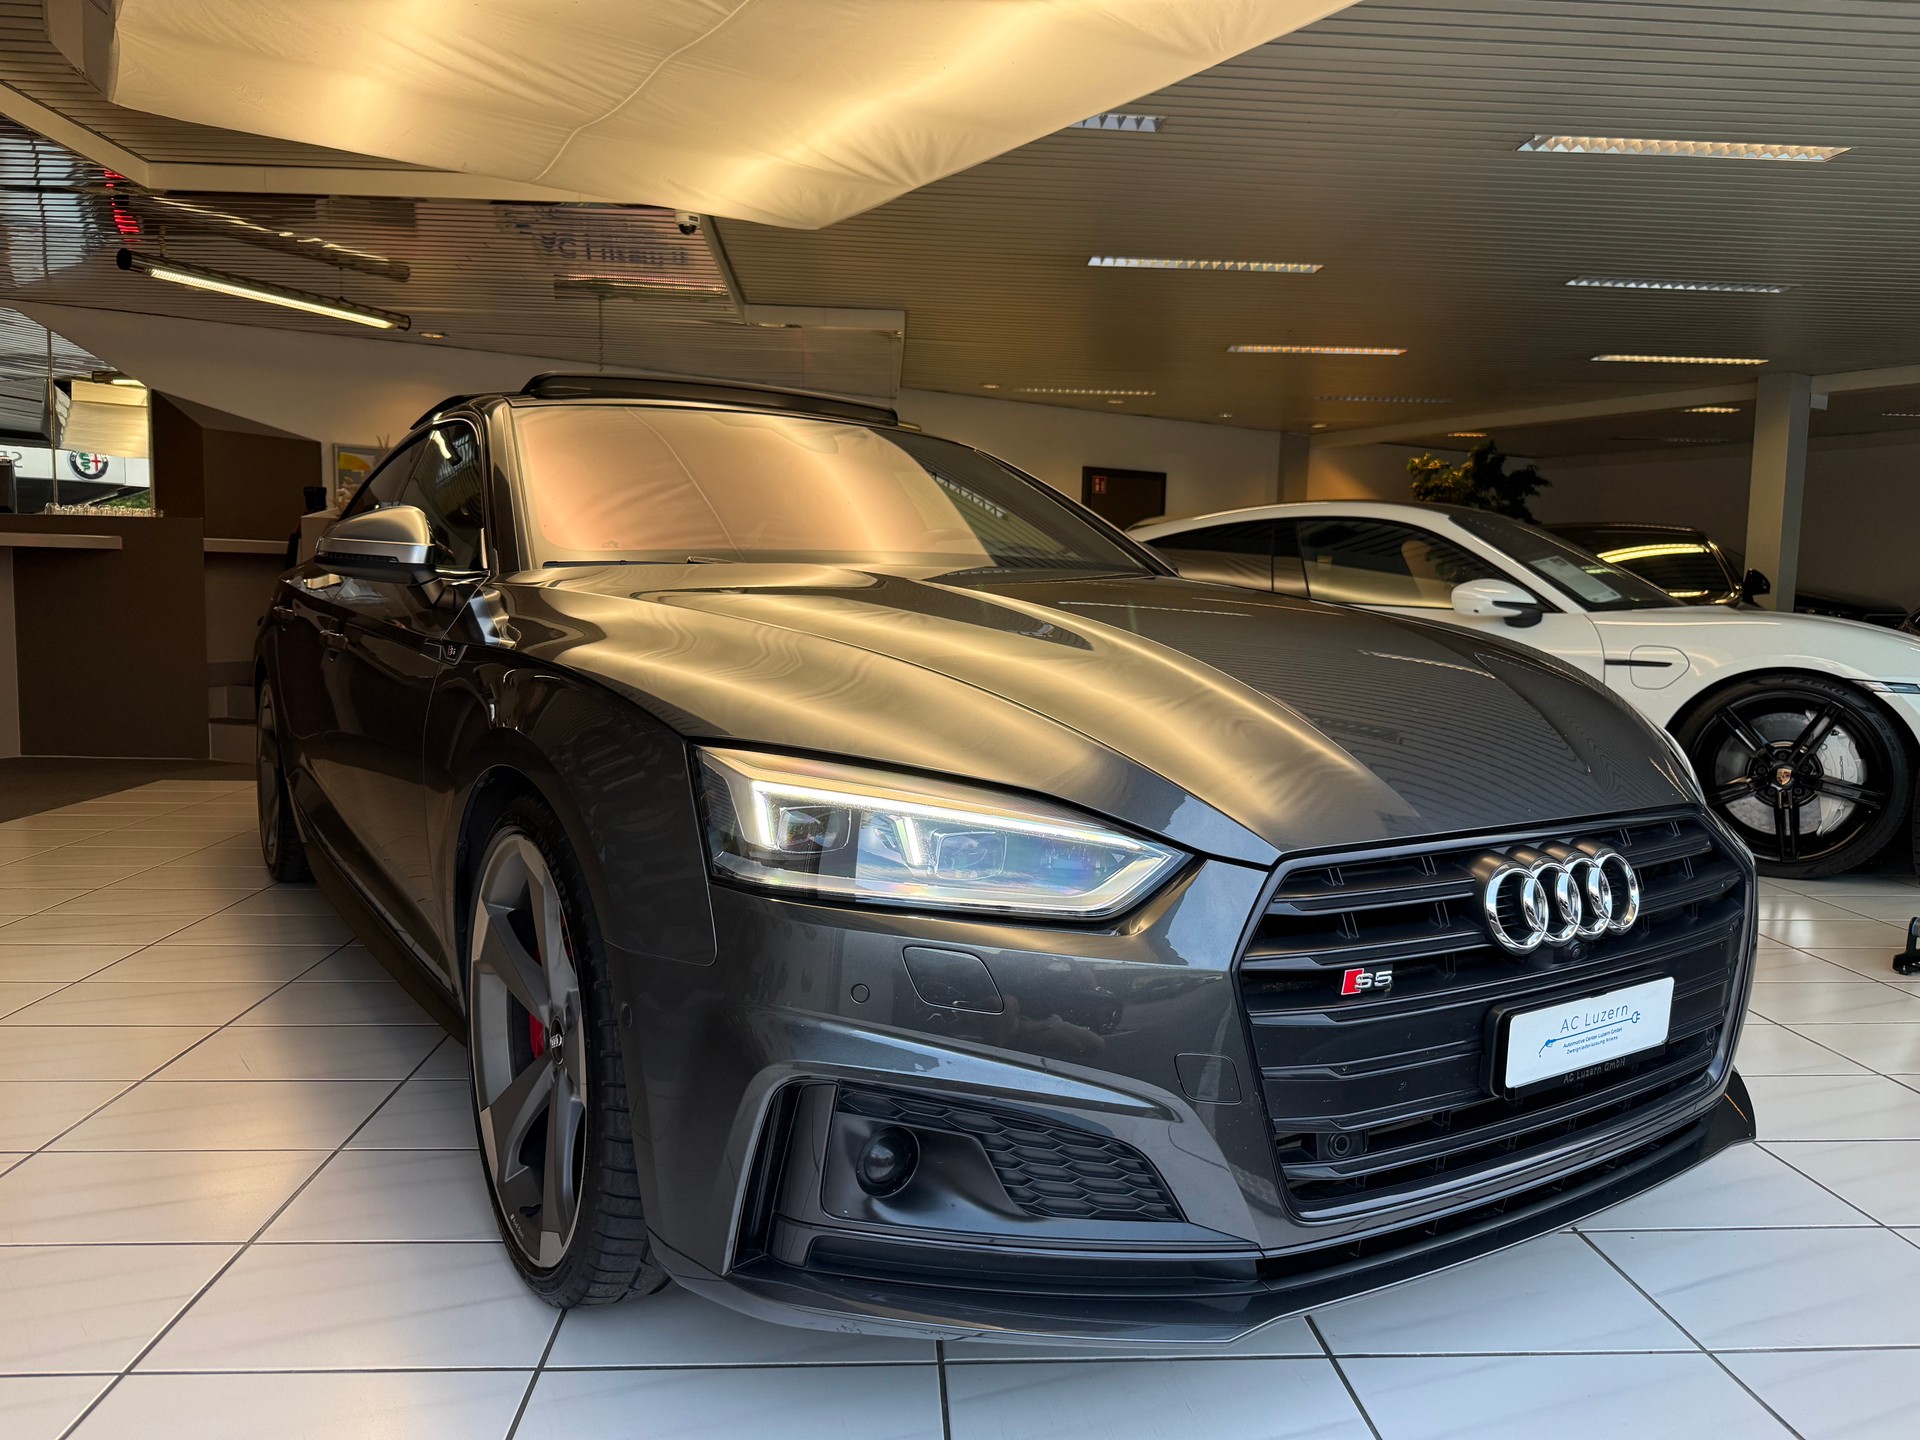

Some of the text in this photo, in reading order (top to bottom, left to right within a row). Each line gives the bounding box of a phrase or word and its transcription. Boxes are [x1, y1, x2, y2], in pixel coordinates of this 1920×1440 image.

[536, 829, 573, 916] DUNLOP
[1354, 970, 1392, 991] S5
[1560, 1005, 1629, 1034] AC Luzern
[1563, 1037, 1586, 1049] Automotive
[1563, 1057, 1626, 1084] AC Luzern GmbH
